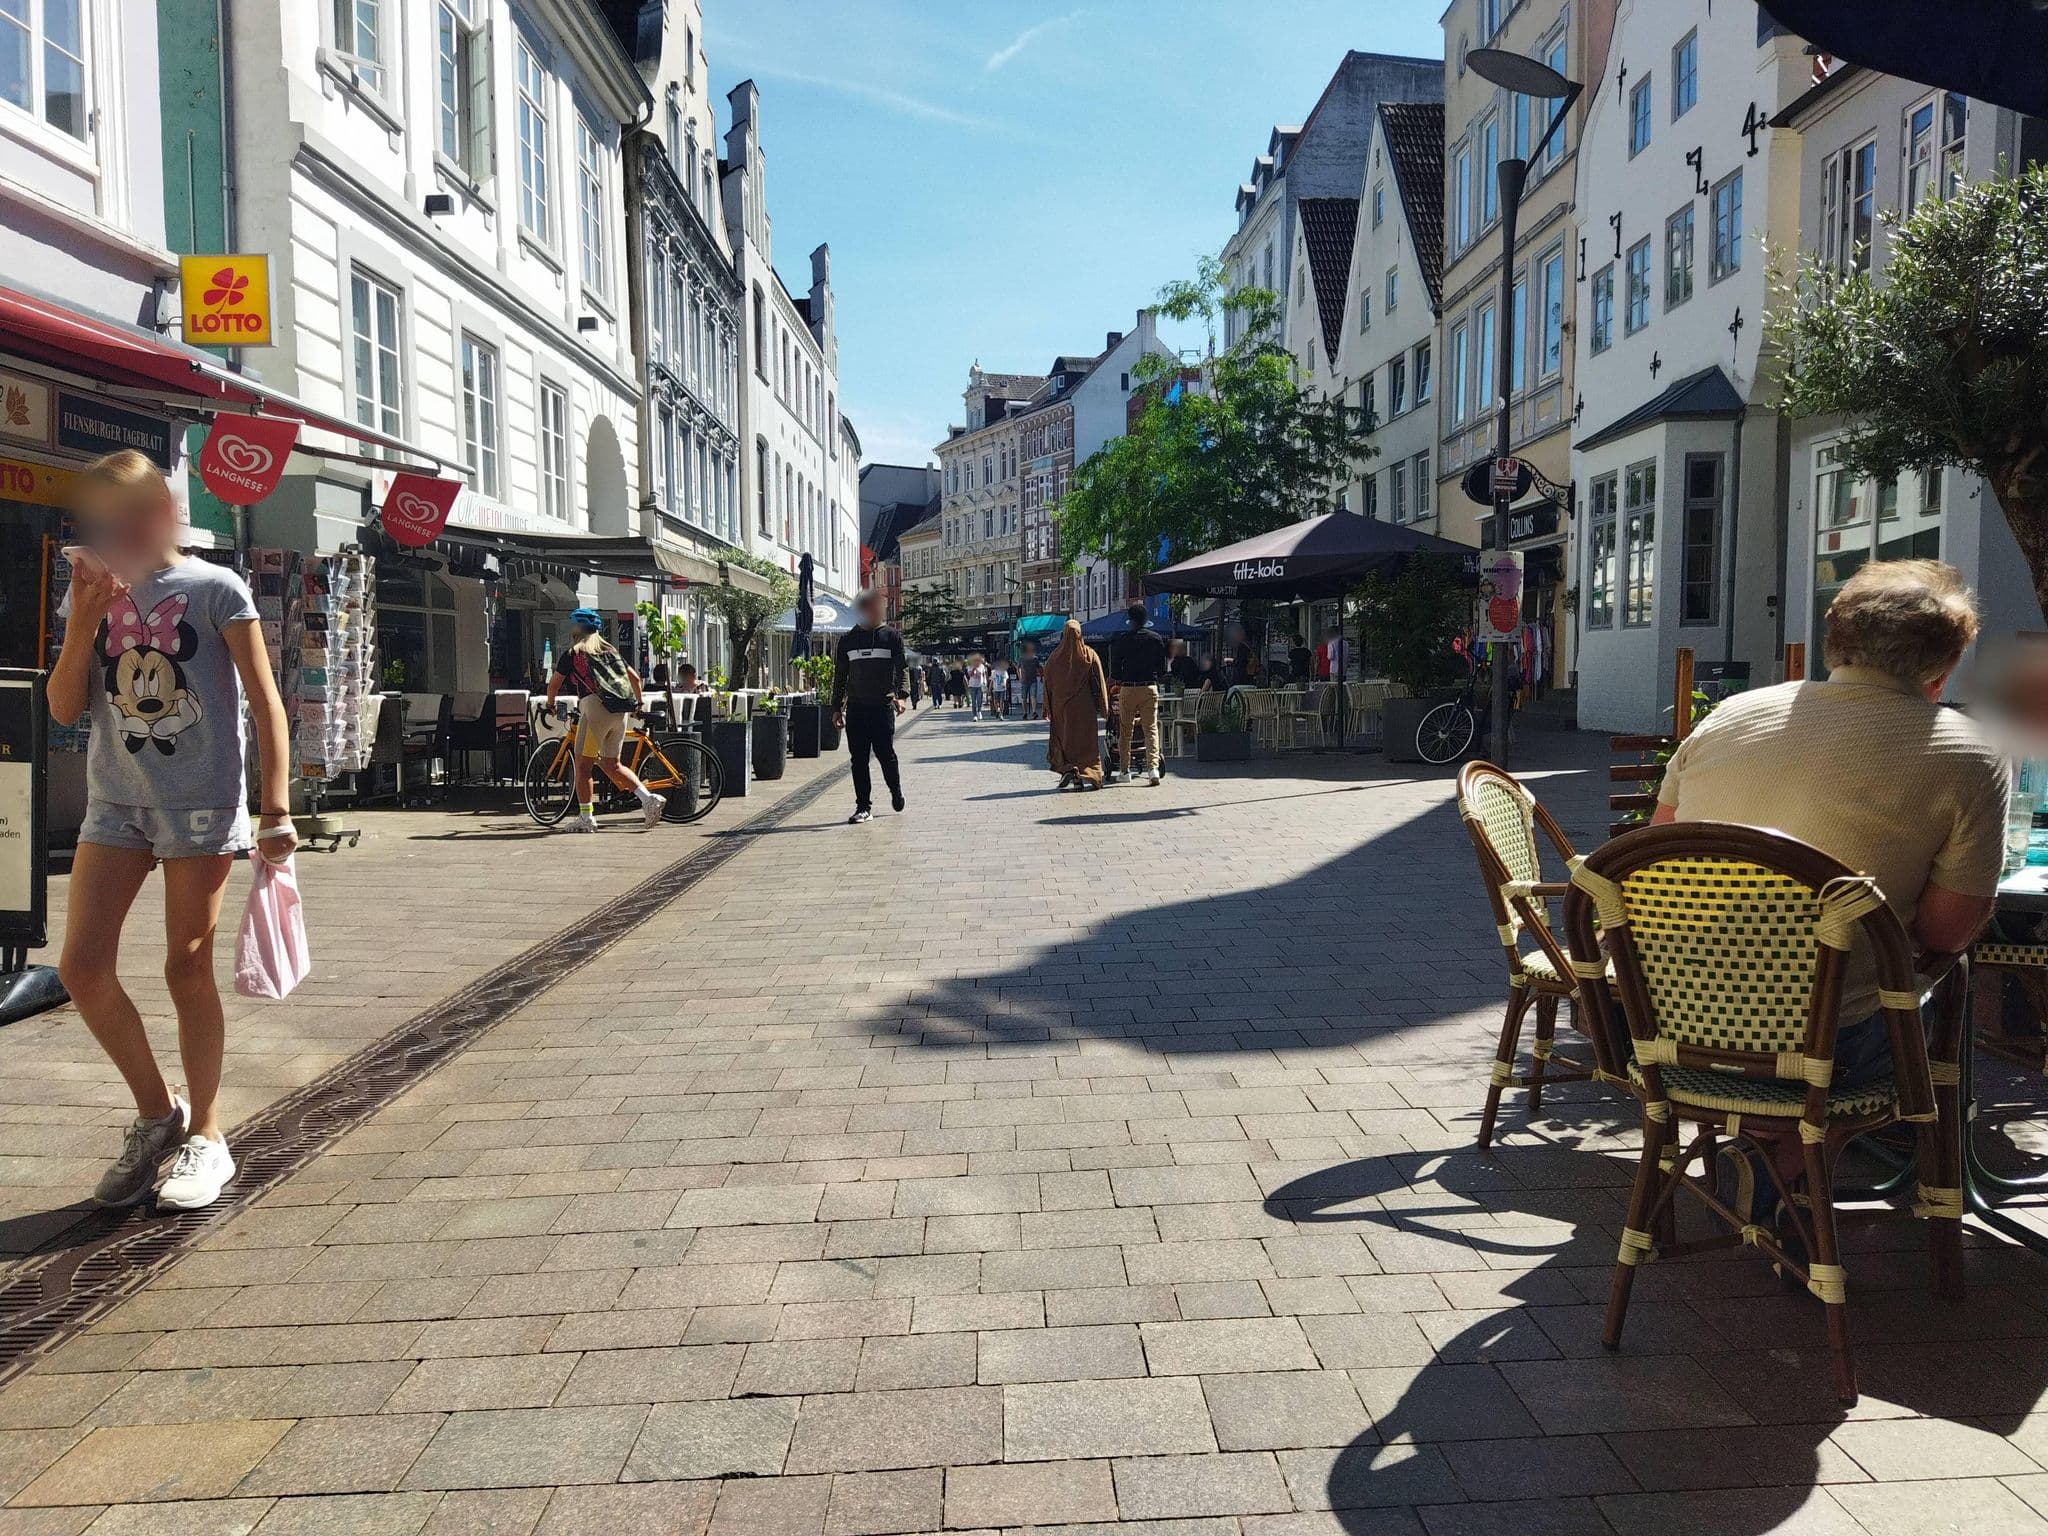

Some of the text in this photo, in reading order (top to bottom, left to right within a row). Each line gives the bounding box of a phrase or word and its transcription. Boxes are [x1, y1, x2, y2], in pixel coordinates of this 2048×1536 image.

[191, 313, 262, 333] LOTTO
[64, 411, 163, 451] FLENSBURGER TAGEBLATT
[206, 463, 263, 493] LANGNESE
[387, 514, 432, 538] LANGNESE
[1511, 515, 1534, 539] COLLINS
[1233, 560, 1284, 580] fritz-kola
